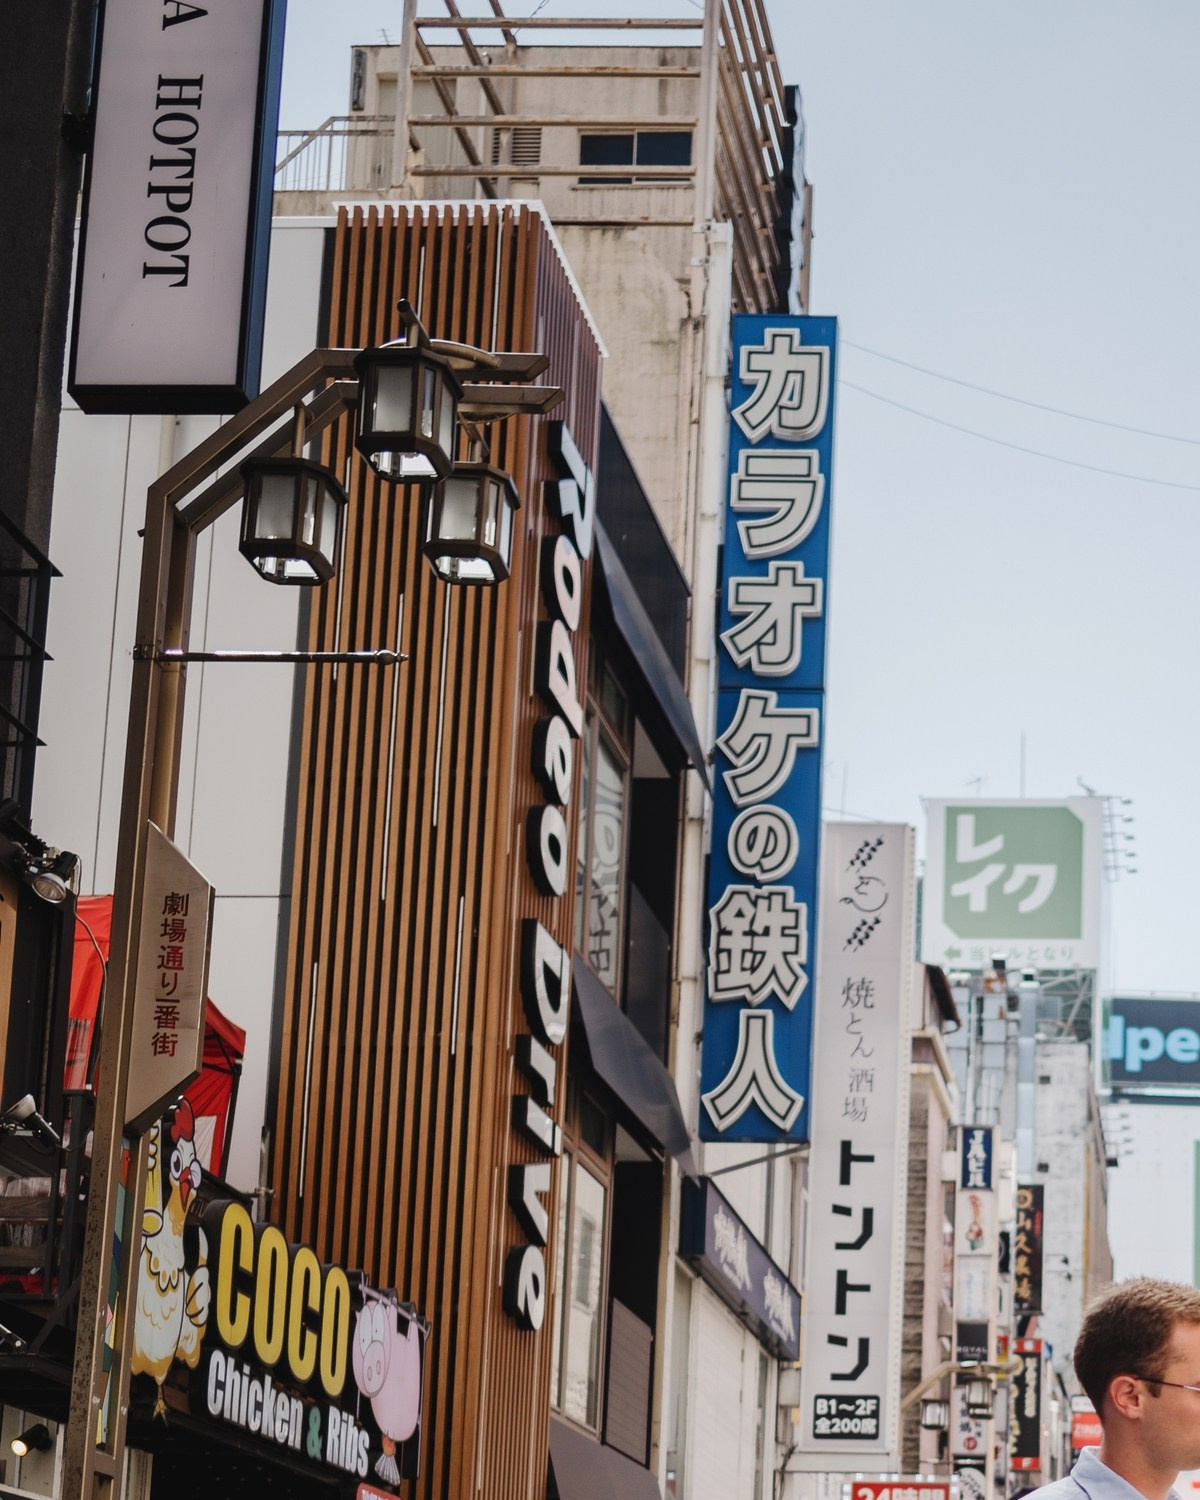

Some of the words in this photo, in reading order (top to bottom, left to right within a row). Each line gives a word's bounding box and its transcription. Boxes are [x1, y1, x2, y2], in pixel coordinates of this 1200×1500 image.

[142, 73, 204, 288] HOTPOT
[527, 420, 595, 897] Rodeo
[702, 327, 831, 1134] カラオケの鉄人
[151, 891, 189, 1058] 劇場通り一番街
[840, 976, 877, 1124] 焼とん酒場
[504, 918, 571, 1332] Drive
[215, 1202, 351, 1398] COCO
[826, 1140, 876, 1381] トントン
[206, 1349, 304, 1451] Chicken
[306, 1404, 323, 1459] &
[326, 1404, 370, 1479] Ribs
[814, 1417, 878, 1435] 全200席
[815, 1398, 878, 1416] B1〜2F
